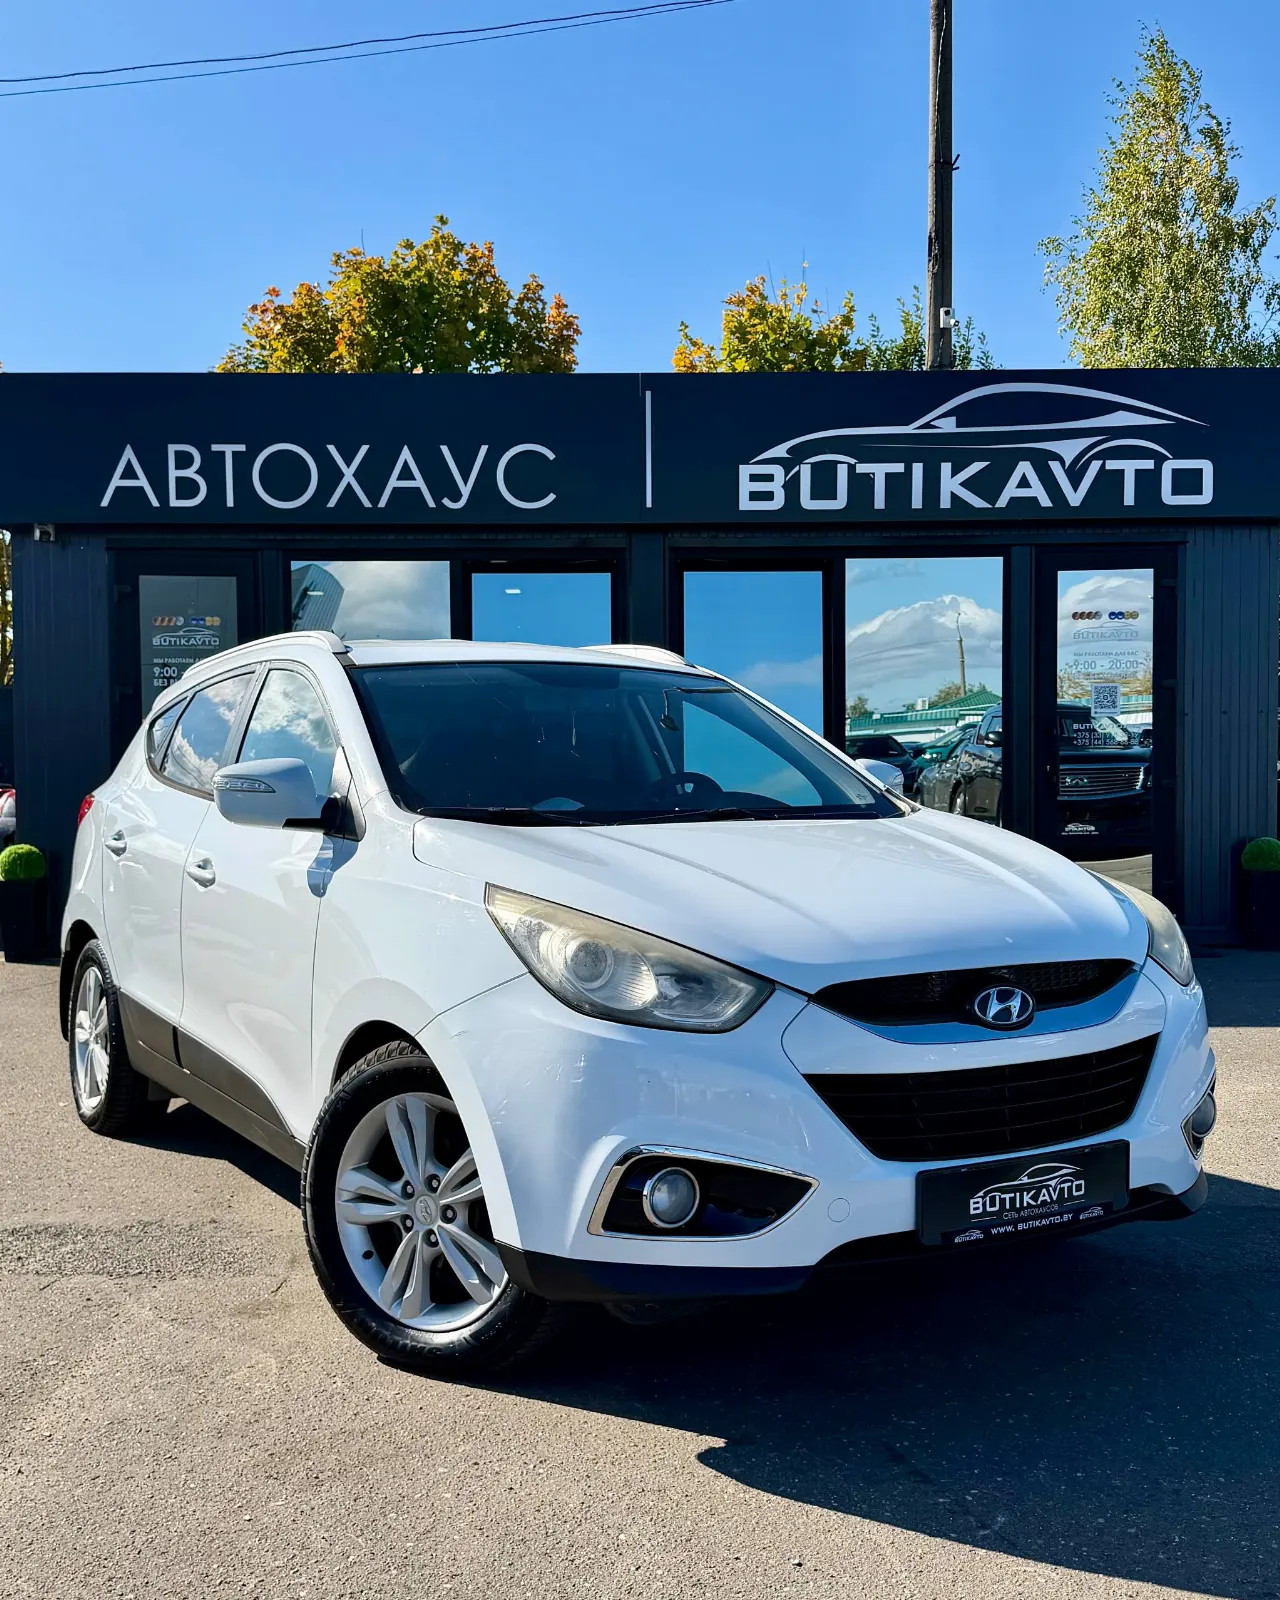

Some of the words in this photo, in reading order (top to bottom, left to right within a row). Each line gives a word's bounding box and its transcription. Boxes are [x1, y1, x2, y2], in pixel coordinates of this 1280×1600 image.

[100, 443, 557, 510] АВТОХАУС
[738, 458, 1214, 511] BUTIKAVTO
[1073, 631, 1139, 639] BUTIKAVTO
[152, 637, 219, 646] BUTIKAVTO
[1073, 659, 1097, 670] 9:00
[1108, 659, 1139, 670] 20:00
[153, 666, 178, 677] 9:00
[153, 678, 168, 687] БЕЗ
[1073, 731, 1090, 739] +375
[969, 1179, 1085, 1215] BUTIKAVTO
[1002, 1211, 1019, 1220] СЕТЬ
[1017, 1213, 1074, 1230] BUTIKAVTO.BY
